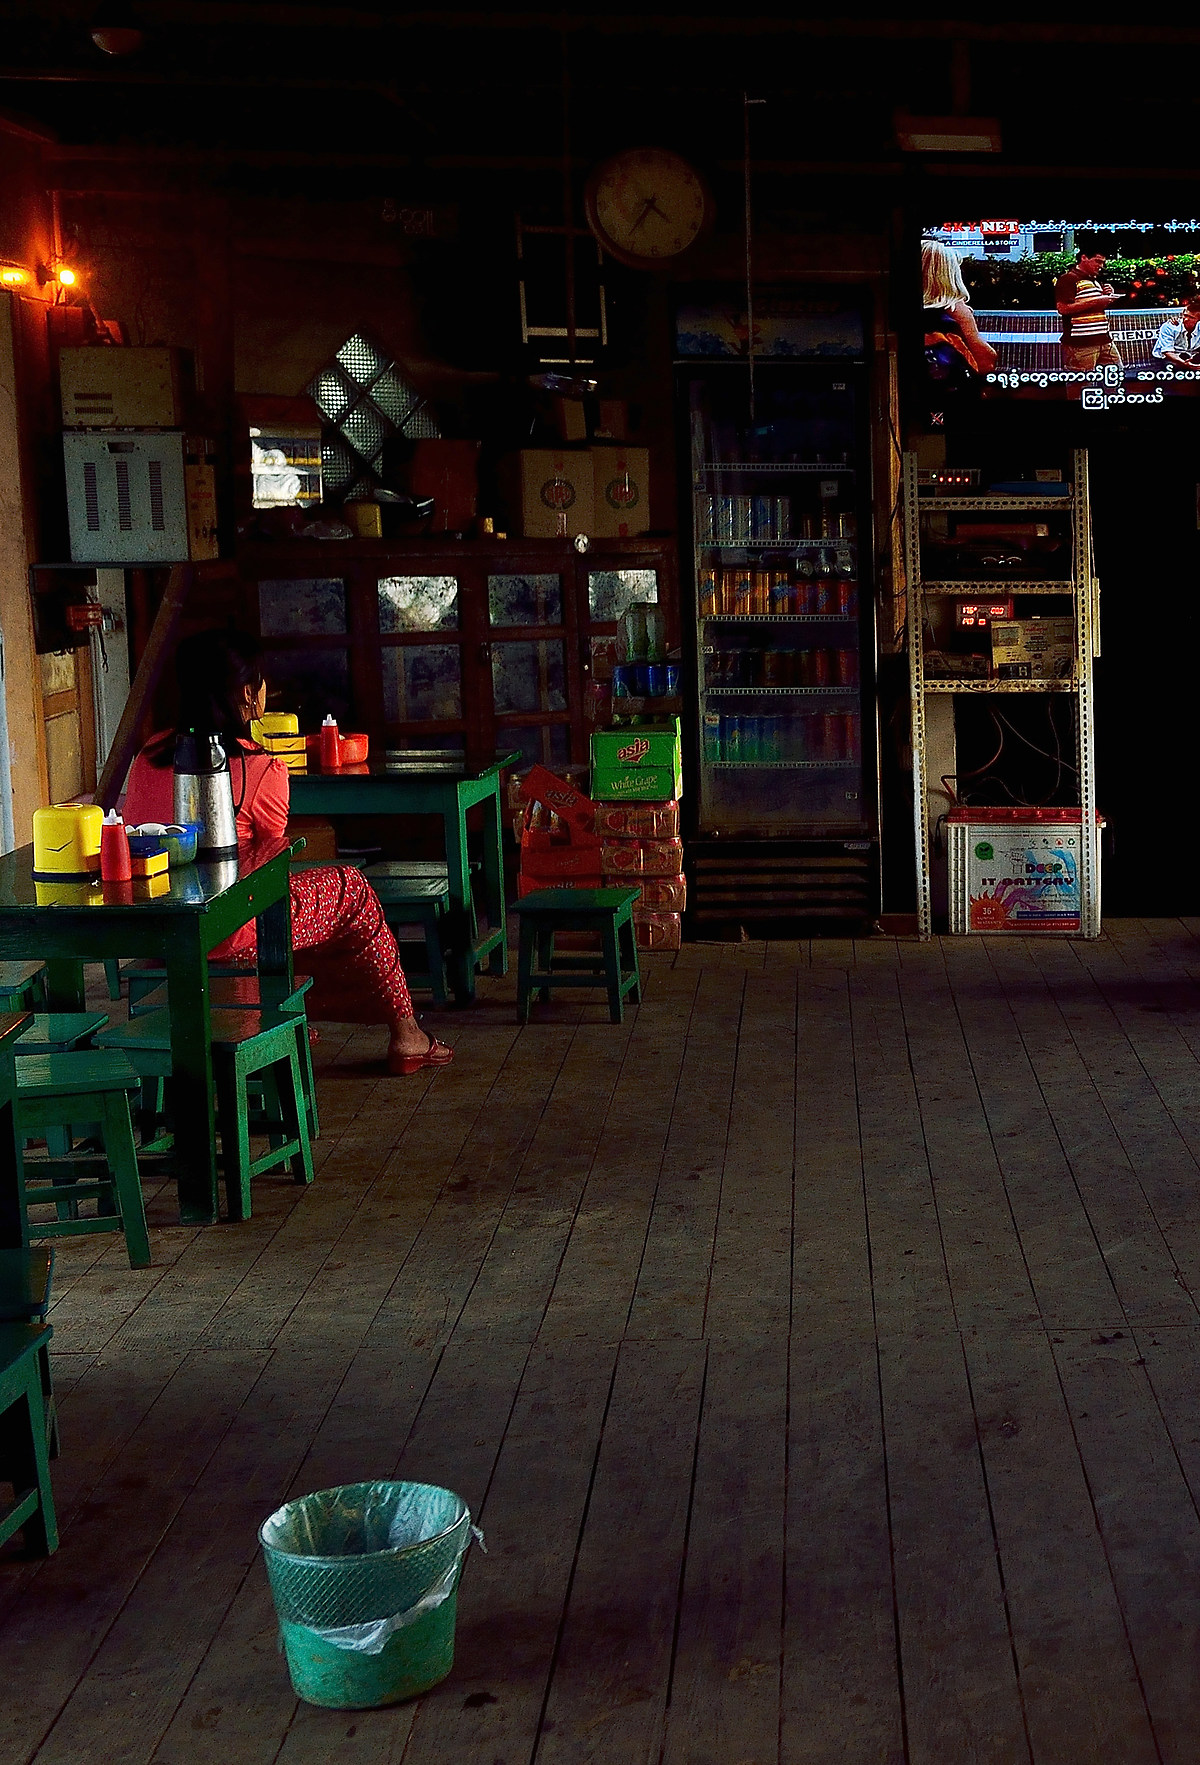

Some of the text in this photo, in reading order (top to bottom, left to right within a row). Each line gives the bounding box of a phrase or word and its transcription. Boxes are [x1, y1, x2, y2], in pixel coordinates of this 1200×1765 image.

[695, 196, 703, 209] 3
[943, 221, 977, 232] SKY
[981, 221, 1019, 232] NET
[1111, 330, 1160, 340] RIEND
[1082, 388, 1164, 410] ကြိုက်တယ်
[617, 738, 649, 758] asia
[611, 776, 635, 791] White
[635, 775, 658, 786] Grape
[1025, 863, 1063, 874] DEEP
